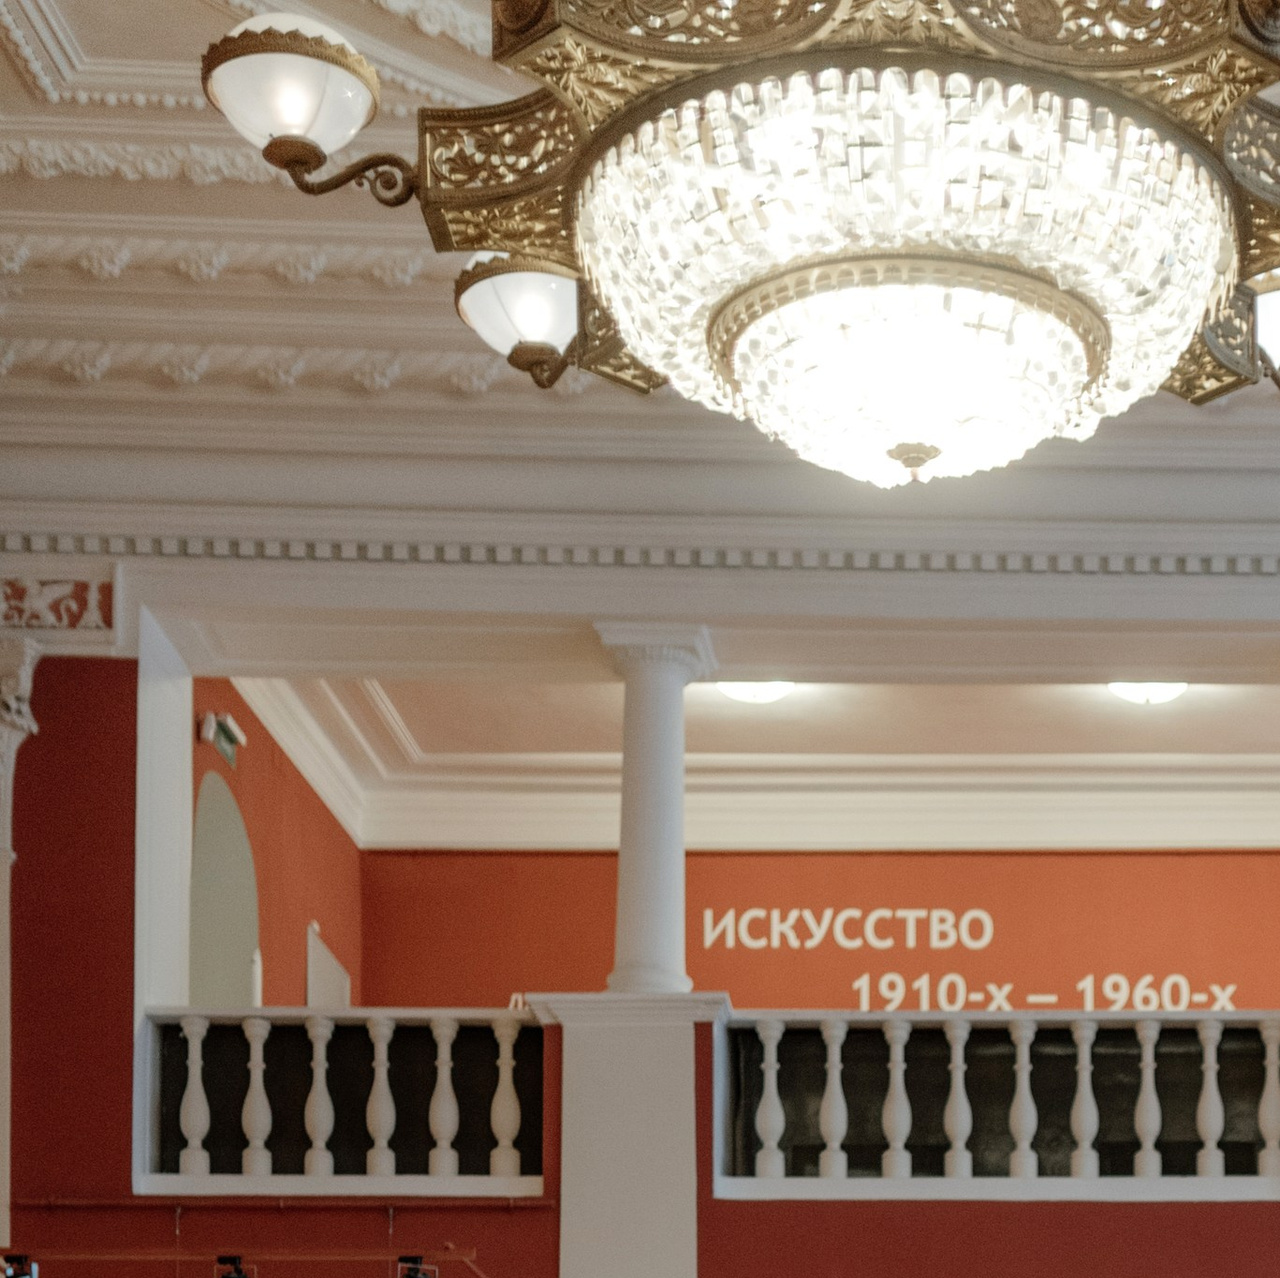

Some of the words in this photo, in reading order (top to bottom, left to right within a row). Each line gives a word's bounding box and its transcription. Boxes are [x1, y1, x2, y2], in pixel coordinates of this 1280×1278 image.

[703, 907, 995, 950] ИСКУССТВО
[851, 972, 1015, 1012] 1910-х
[1075, 972, 1238, 1012] 1960-х
